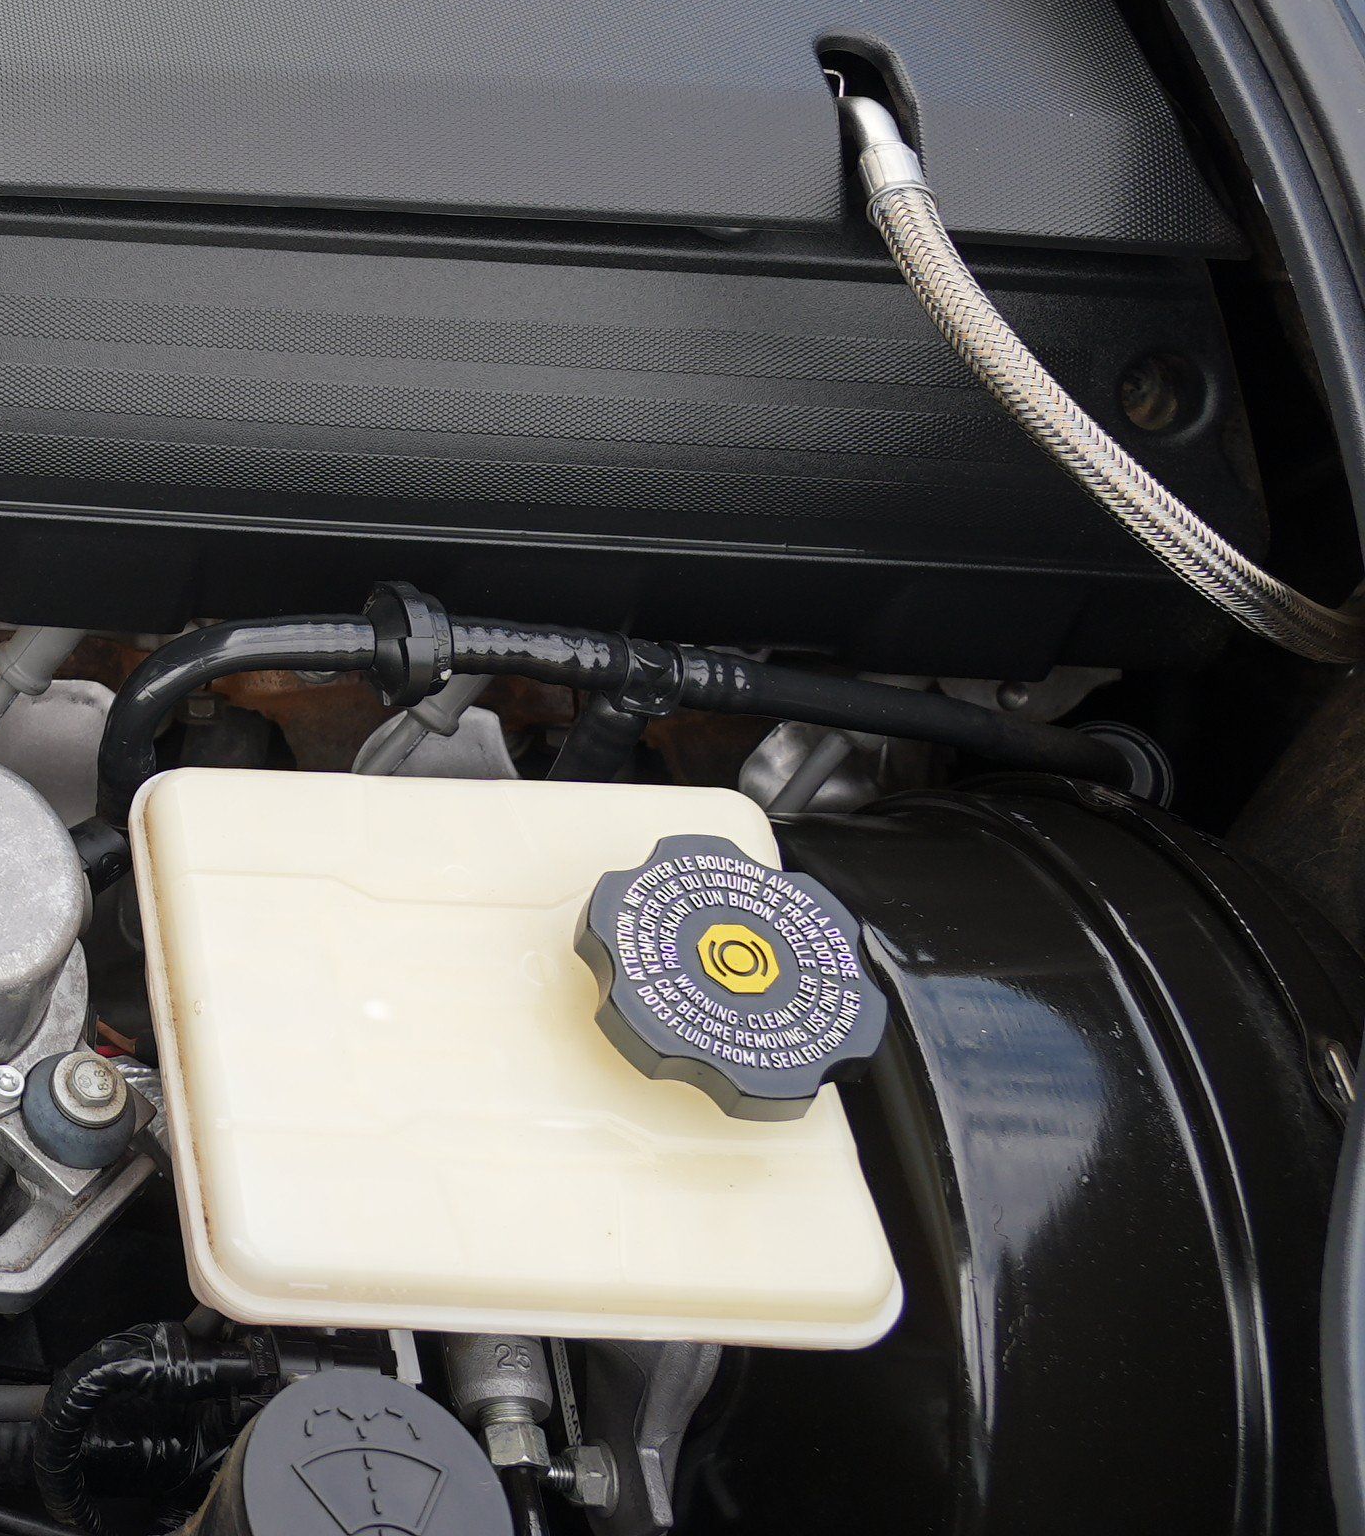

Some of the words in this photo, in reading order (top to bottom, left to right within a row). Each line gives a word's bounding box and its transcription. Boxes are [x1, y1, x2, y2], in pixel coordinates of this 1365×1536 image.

[622, 862, 677, 909] NETTOYER
[674, 856, 696, 873] LE
[694, 855, 765, 881] BOUCHON
[766, 875, 814, 908] AVANT
[616, 909, 647, 981] ATTENTION:
[637, 899, 665, 975] N'EMPLOYER
[654, 880, 684, 904] QUE
[679, 874, 702, 891] DU
[703, 872, 760, 897] LIQUIDE
[762, 887, 783, 908] DE
[781, 903, 821, 941] FREIN
[810, 941, 838, 976] DOT3
[658, 898, 693, 970] PROVENANT
[689, 890, 724, 909] D'UN
[728, 892, 775, 922] BIDON
[773, 918, 816, 972] SCELLE.
[808, 907, 831, 928] LA
[823, 927, 860, 982] DEPOSE.
[636, 985, 673, 1021] DOT3
[667, 1017, 711, 1050] FLUID
[711, 1041, 756, 1067] FROM
[759, 1052, 770, 1069] A
[770, 1043, 824, 1069] SEALED
[816, 989, 862, 1054] CONTAINER.
[654, 978, 681, 1003] CAP
[676, 1001, 732, 1041] BEFORE
[735, 1026, 812, 1050] REMOVING.
[802, 1008, 831, 1035] USE
[818, 978, 840, 1012] ONLY
[673, 973, 744, 1026] WARNING:
[747, 1008, 796, 1030] CLEAN
[787, 974, 818, 1018] FILLER
[493, 1343, 533, 1373] 25
